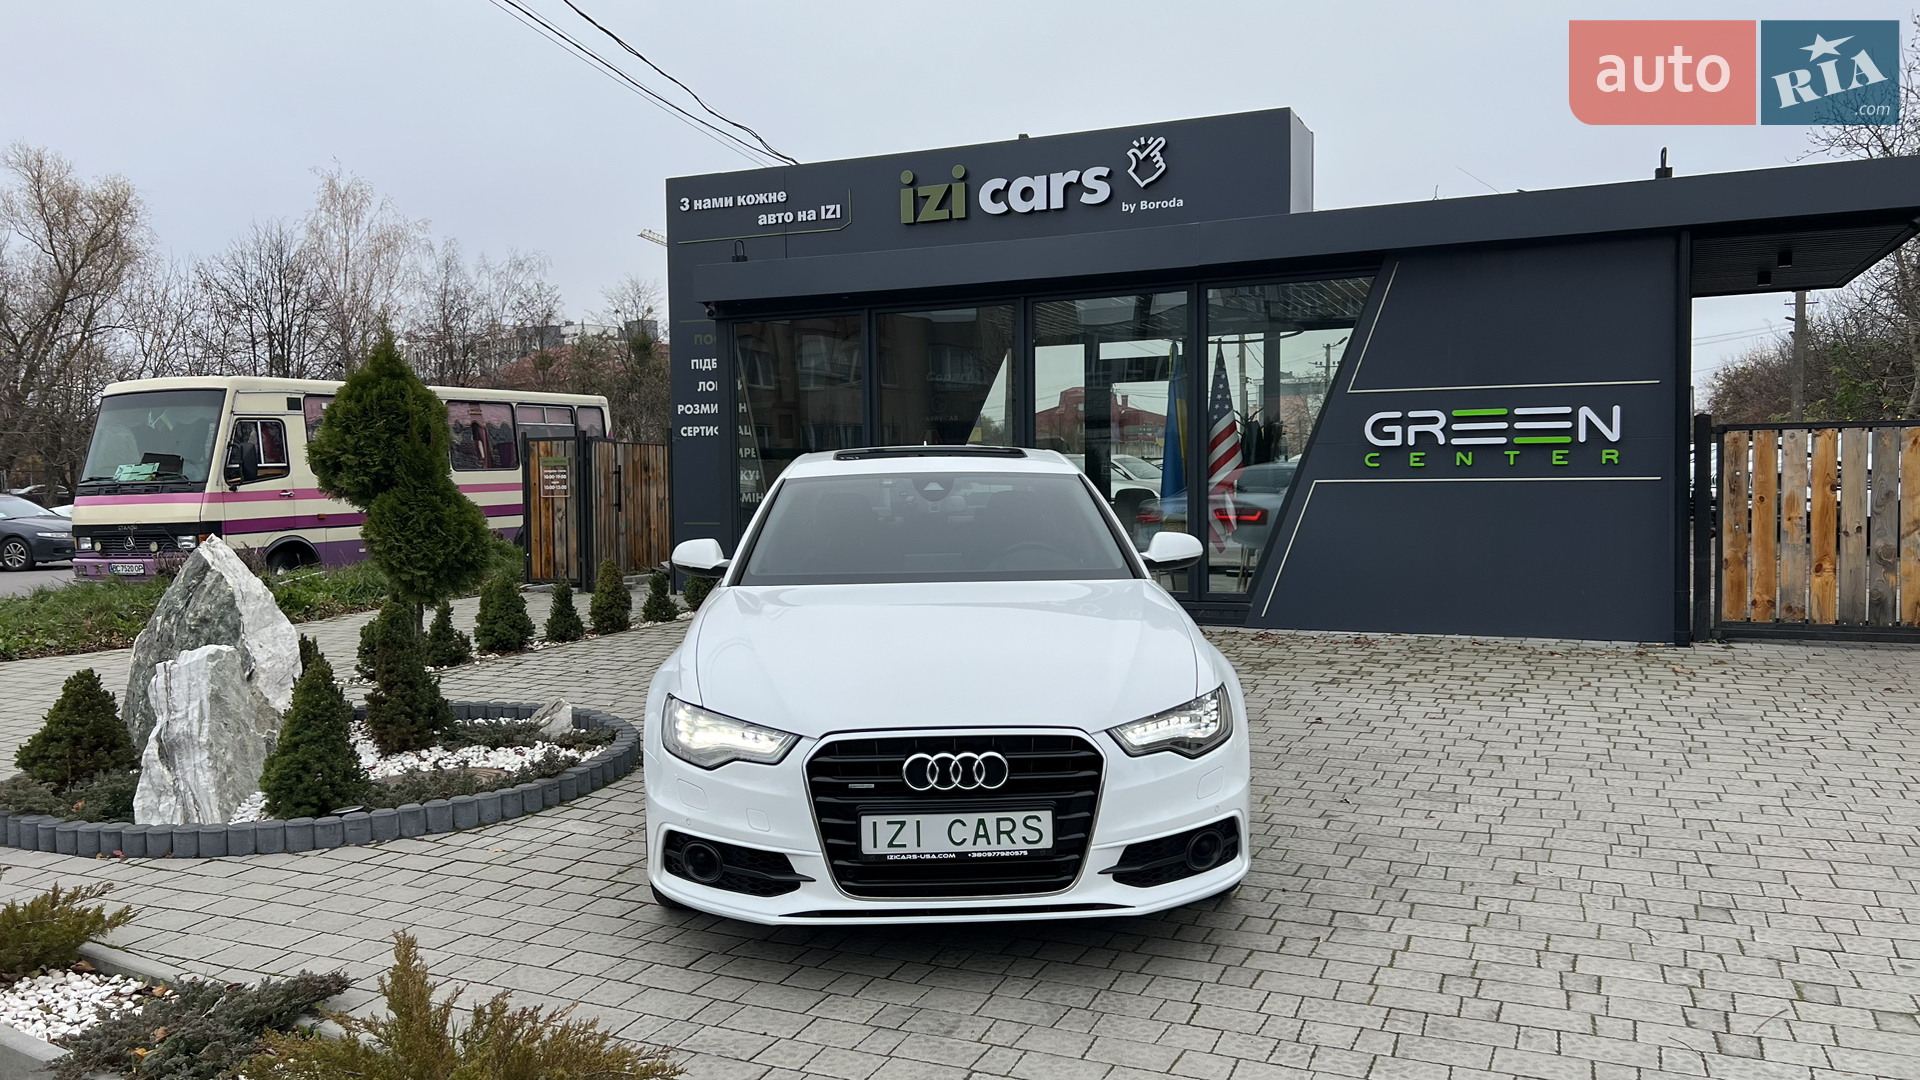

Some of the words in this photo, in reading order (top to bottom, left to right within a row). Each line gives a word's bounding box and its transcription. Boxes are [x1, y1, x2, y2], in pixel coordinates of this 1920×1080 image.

[693, 196, 734, 210] нами
[736, 190, 788, 207] кожне
[900, 165, 966, 224] izi
[978, 167, 1111, 215] cars
[757, 211, 795, 226] авто
[797, 208, 818, 222] на
[820, 204, 842, 220] IZI
[1122, 202, 1136, 214] by
[1140, 198, 1184, 211] Boroda
[1364, 404, 1621, 447] GREEN
[1364, 449, 1620, 467] CENTER
[872, 819, 921, 849] IZI
[946, 814, 1044, 847] CARS
